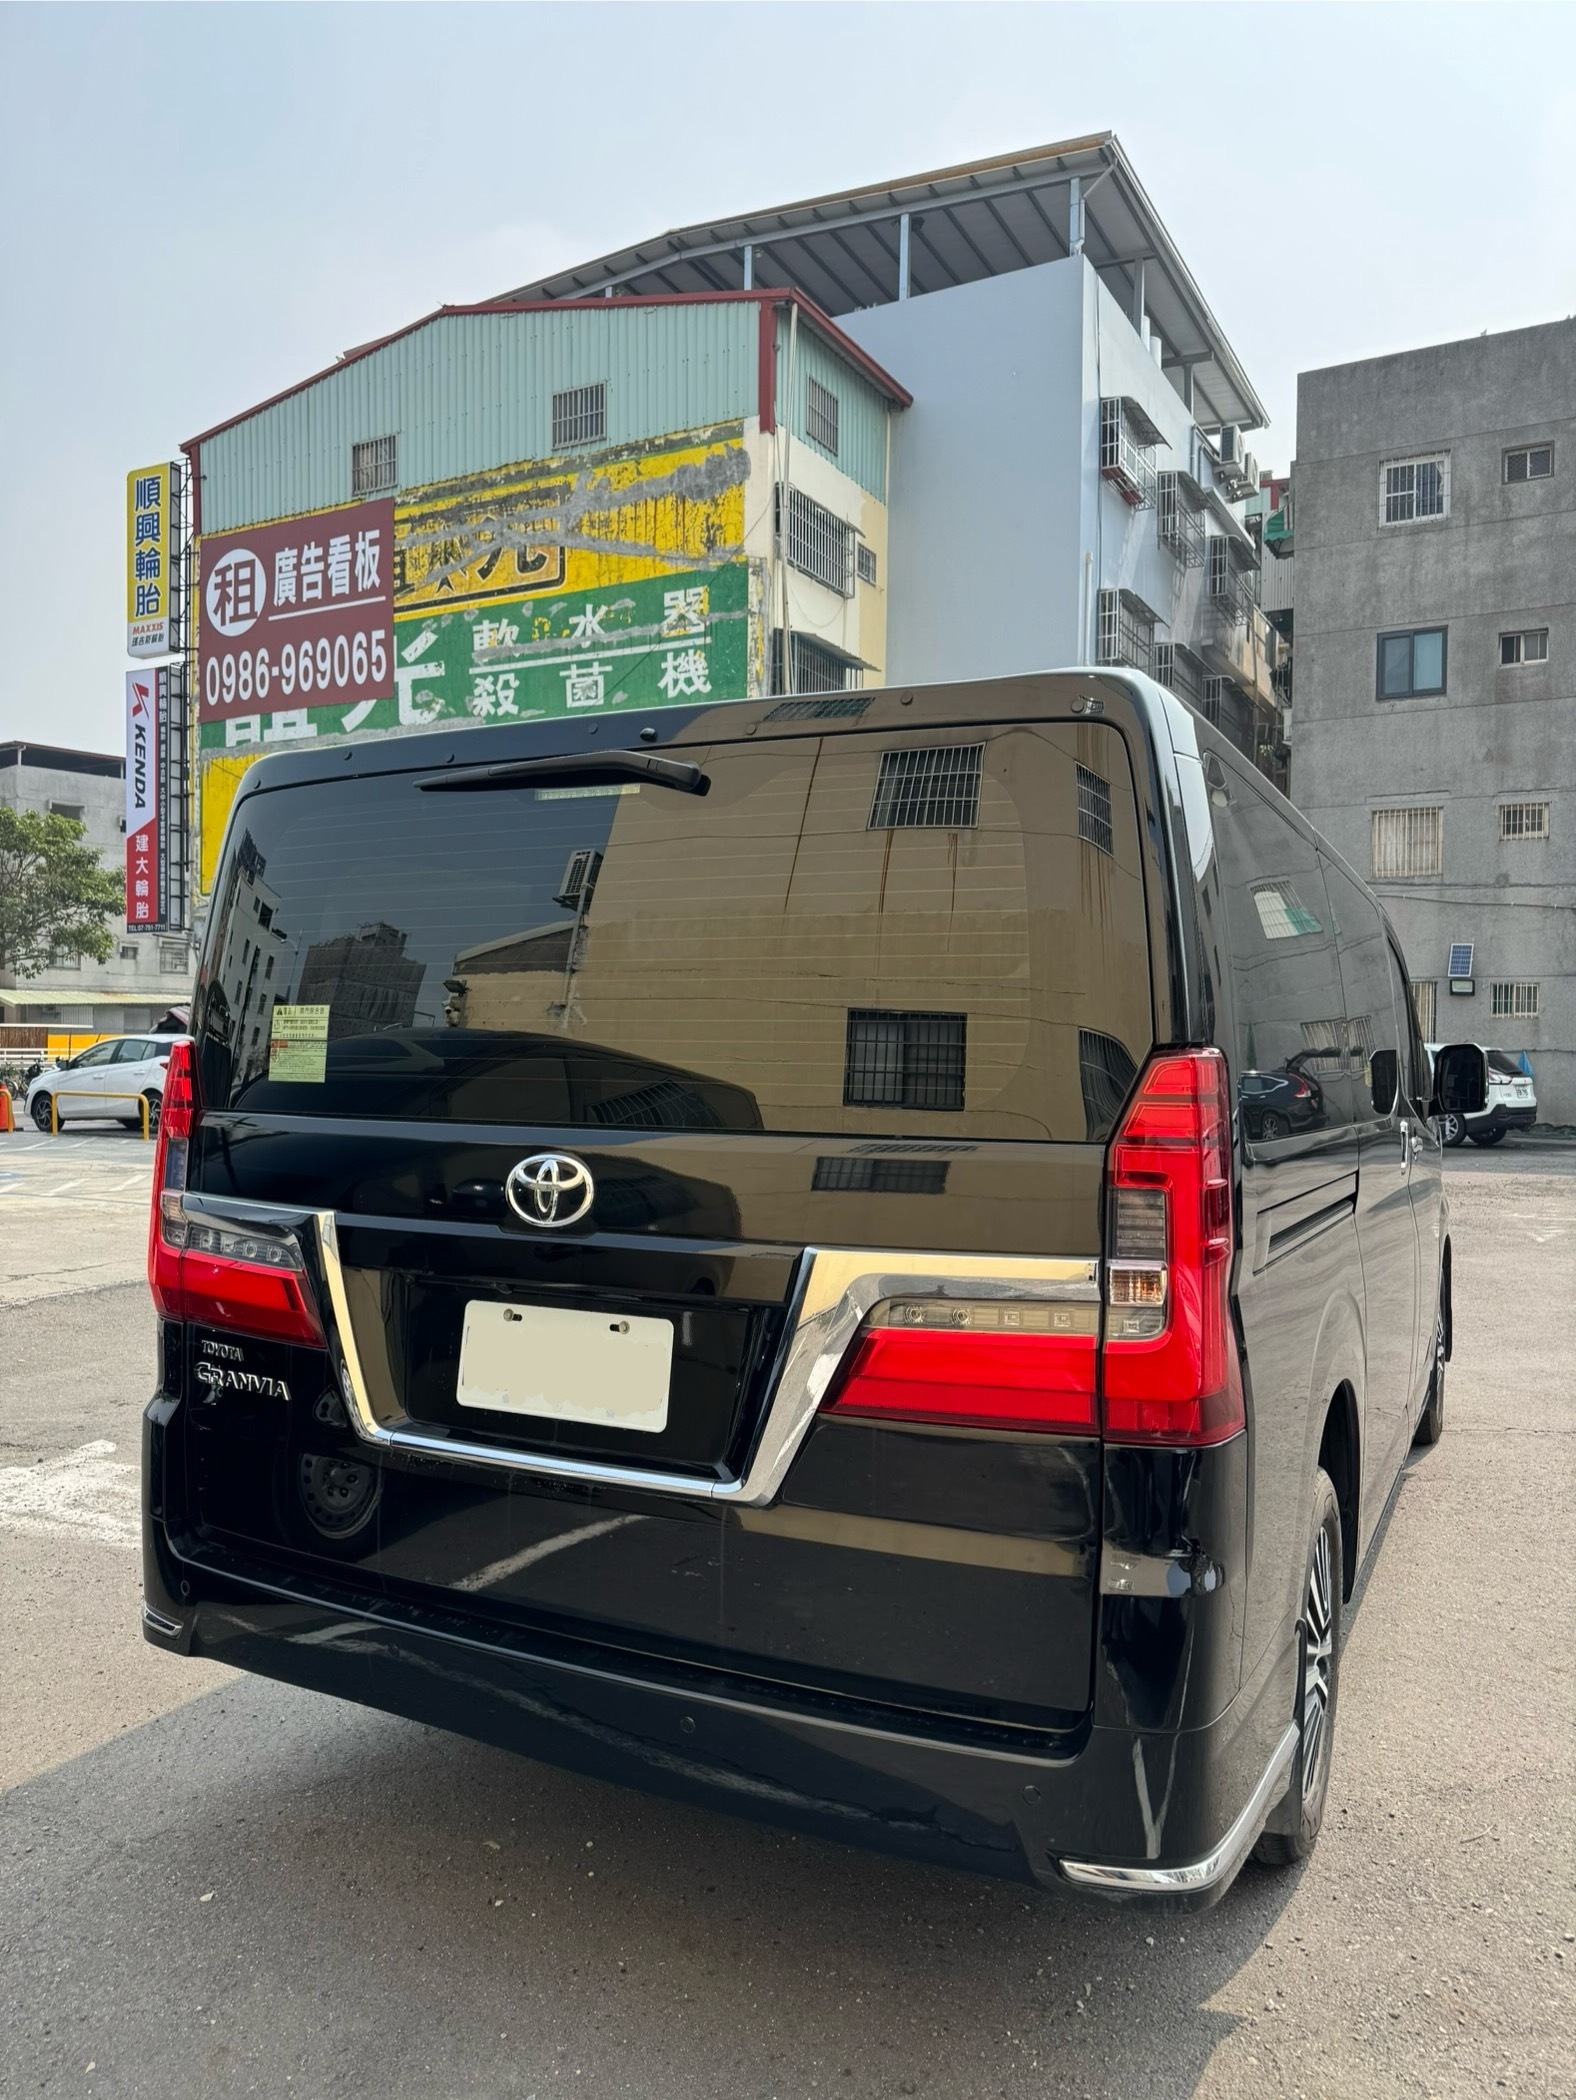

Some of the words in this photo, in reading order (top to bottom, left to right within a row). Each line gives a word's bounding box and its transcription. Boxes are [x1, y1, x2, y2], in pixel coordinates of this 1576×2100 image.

[135, 476, 161, 617] 順興輪胎
[212, 558, 258, 627] 租
[273, 529, 381, 607] 廣告看板
[132, 623, 163, 635] MAXXIS
[206, 629, 387, 706] 0986-969065
[472, 648, 712, 716] 殺菌機
[135, 723, 146, 808] KENDA
[135, 834, 149, 919] 建大輪胎
[194, 1361, 292, 1401] GRANVIA
[201, 1339, 244, 1362] TOYOTA
